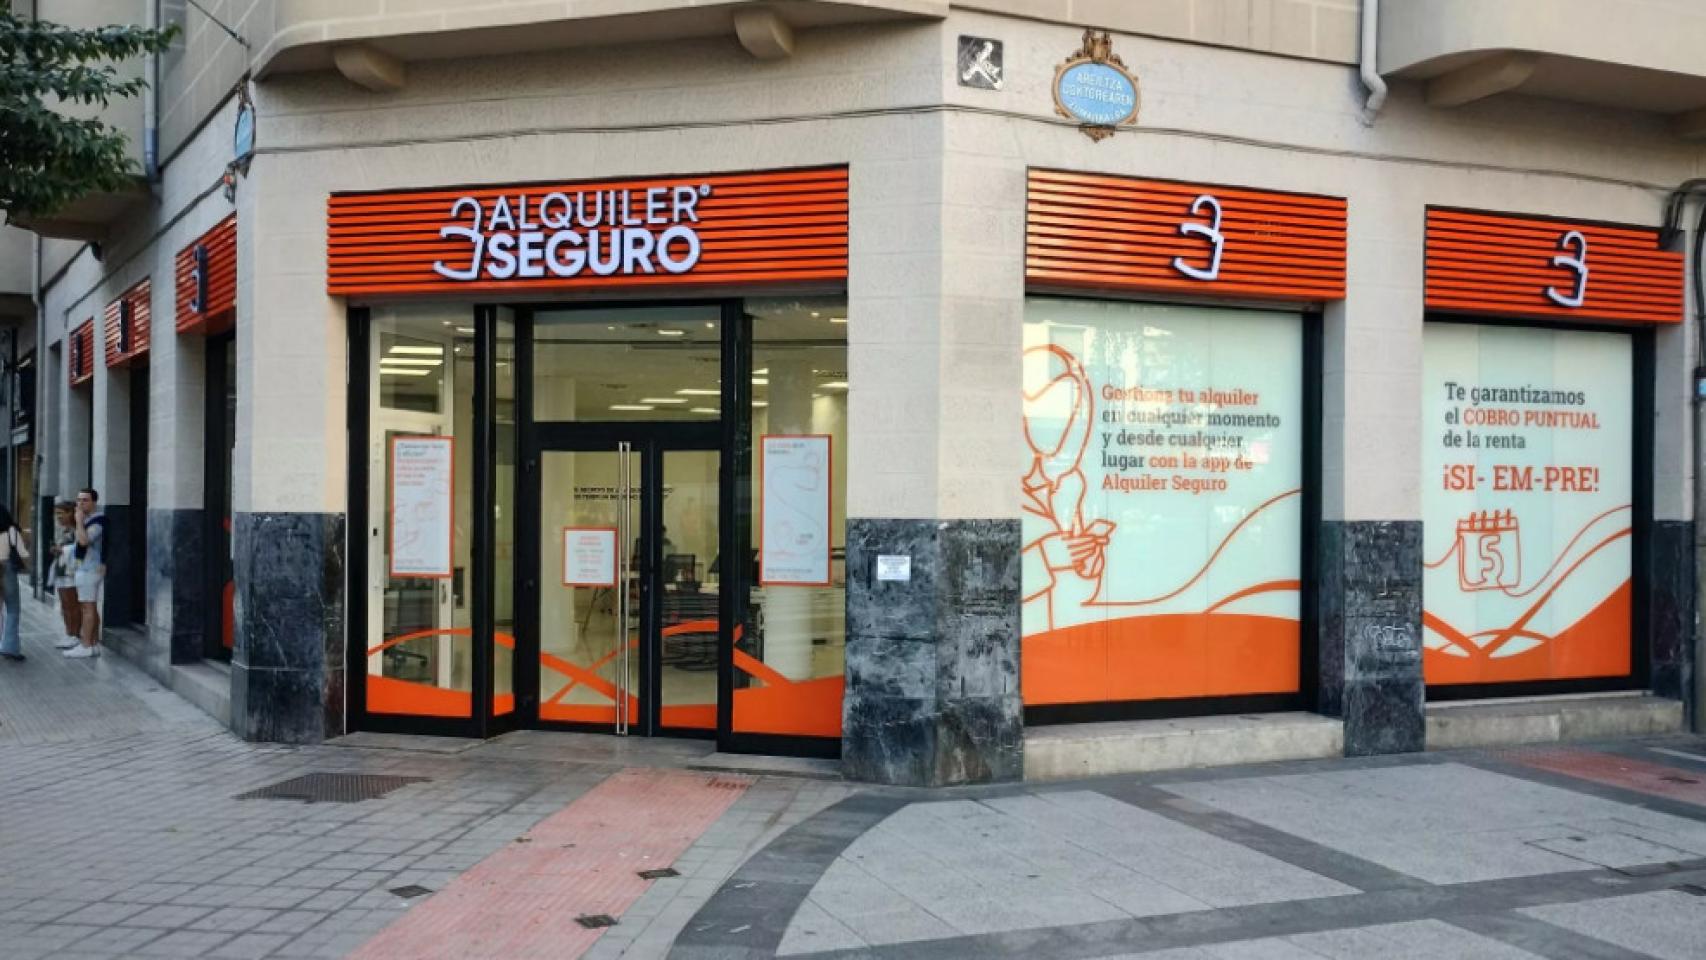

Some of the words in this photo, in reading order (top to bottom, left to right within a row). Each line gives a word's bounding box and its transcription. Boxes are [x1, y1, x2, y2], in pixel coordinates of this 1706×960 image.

[487, 225, 700, 278] SEGURO
[1178, 389, 1194, 403] tu
[1199, 388, 1258, 408] alquiler
[1445, 382, 1465, 401] Te
[1471, 385, 1585, 405] garantizamos
[1102, 411, 1121, 422] en
[1127, 411, 1202, 427] cualquier
[1208, 413, 1280, 427] momento
[1445, 408, 1459, 425] el
[1464, 409, 1519, 426] COBRO
[1524, 411, 1600, 429] PUNTUAL
[1102, 433, 1112, 447] y
[1117, 429, 1164, 446] desde
[1168, 432, 1243, 450] cualquier
[1443, 431, 1461, 447] de
[1467, 431, 1480, 448] la
[1486, 434, 1525, 448] renta
[1102, 451, 1144, 470] lugar
[1149, 456, 1178, 468] con
[1183, 453, 1197, 468] la
[1201, 459, 1229, 473] app
[1235, 455, 1253, 469] de
[1102, 475, 1167, 493] Alquiler
[1172, 476, 1227, 494] Seguro
